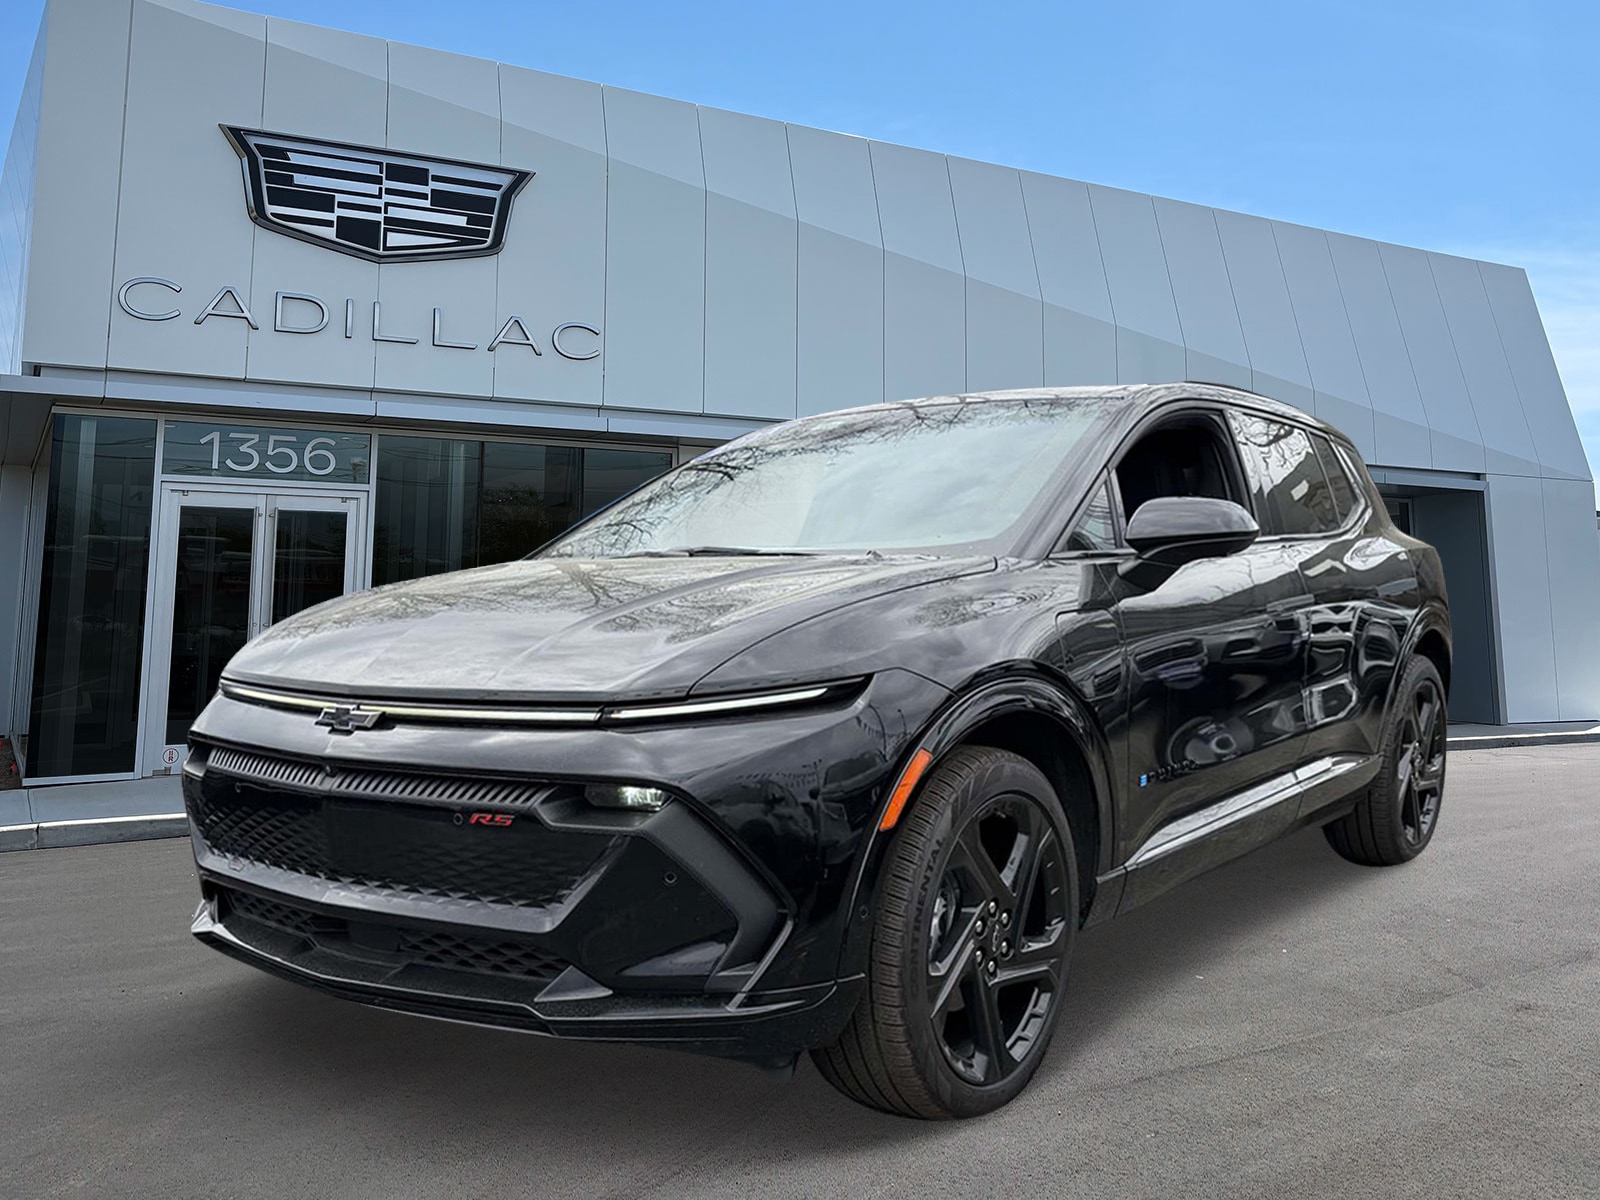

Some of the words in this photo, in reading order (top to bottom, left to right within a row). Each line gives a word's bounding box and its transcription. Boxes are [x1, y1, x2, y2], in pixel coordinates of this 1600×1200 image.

[118, 276, 600, 361] CADILLAC
[200, 432, 336, 475] 1356
[469, 813, 515, 826] RS
[910, 838, 945, 998] CONTINENTAL
